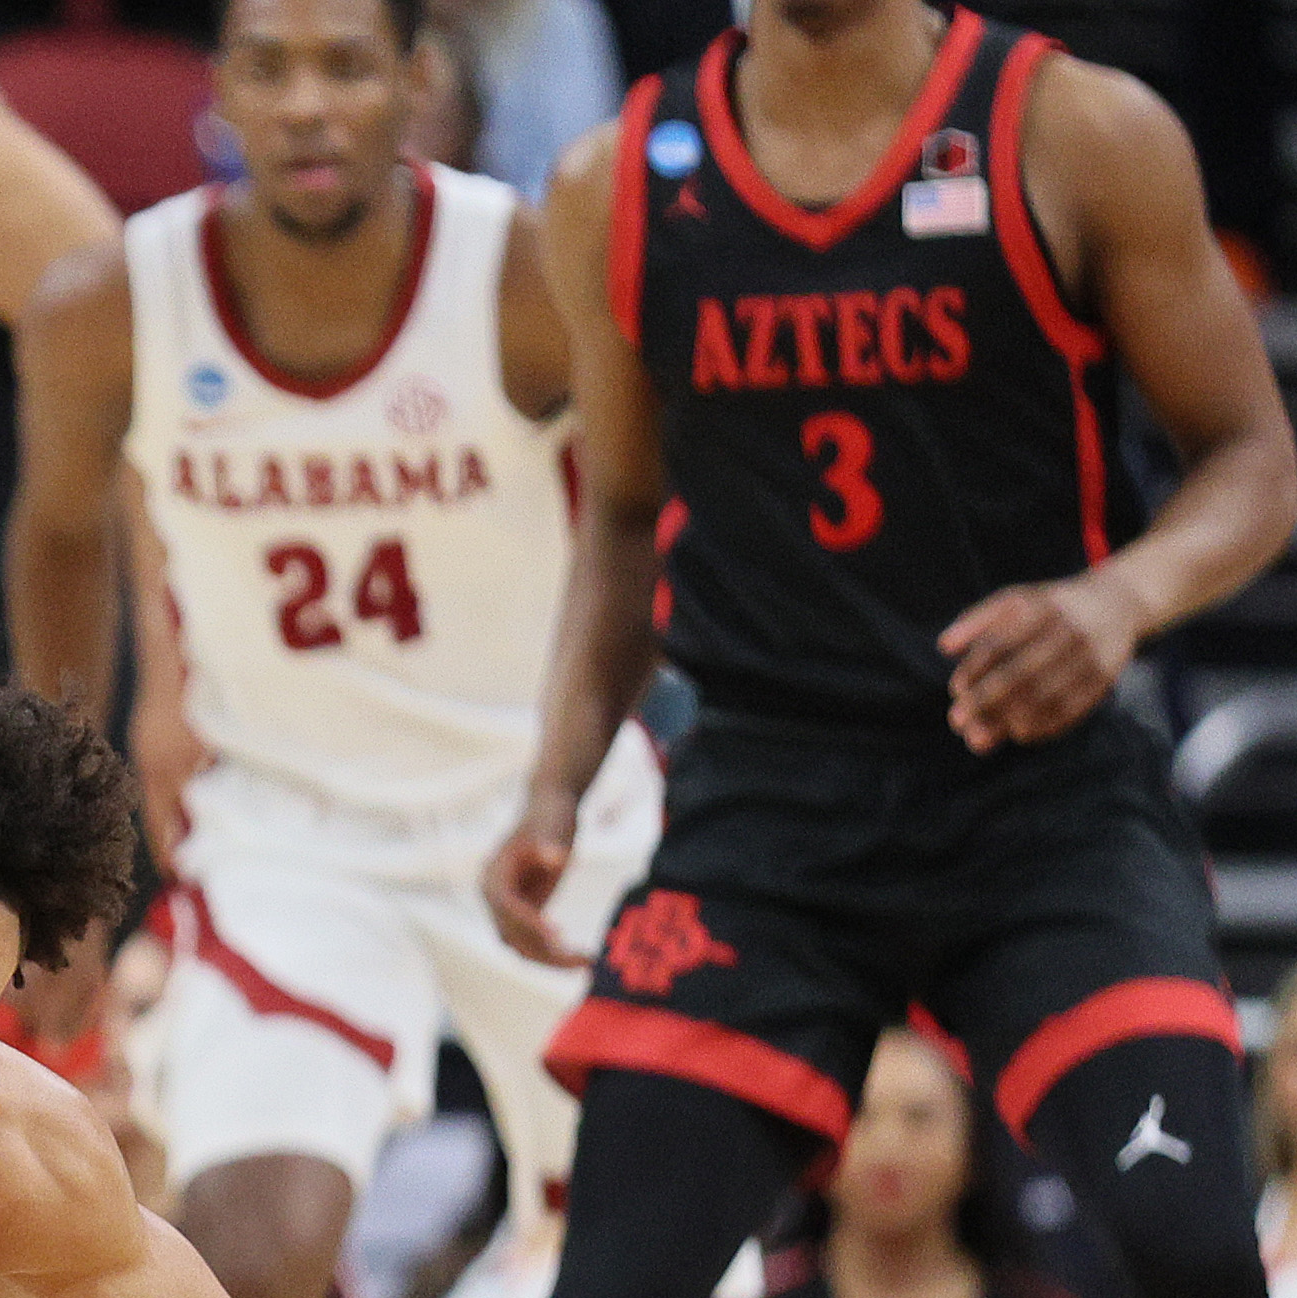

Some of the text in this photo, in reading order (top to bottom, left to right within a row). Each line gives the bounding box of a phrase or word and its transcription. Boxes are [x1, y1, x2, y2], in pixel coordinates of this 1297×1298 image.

[691, 286, 972, 393] AZTECS
[171, 447, 489, 508] ALABAMA
[800, 409, 884, 552] 3
[265, 533, 422, 651] 24
